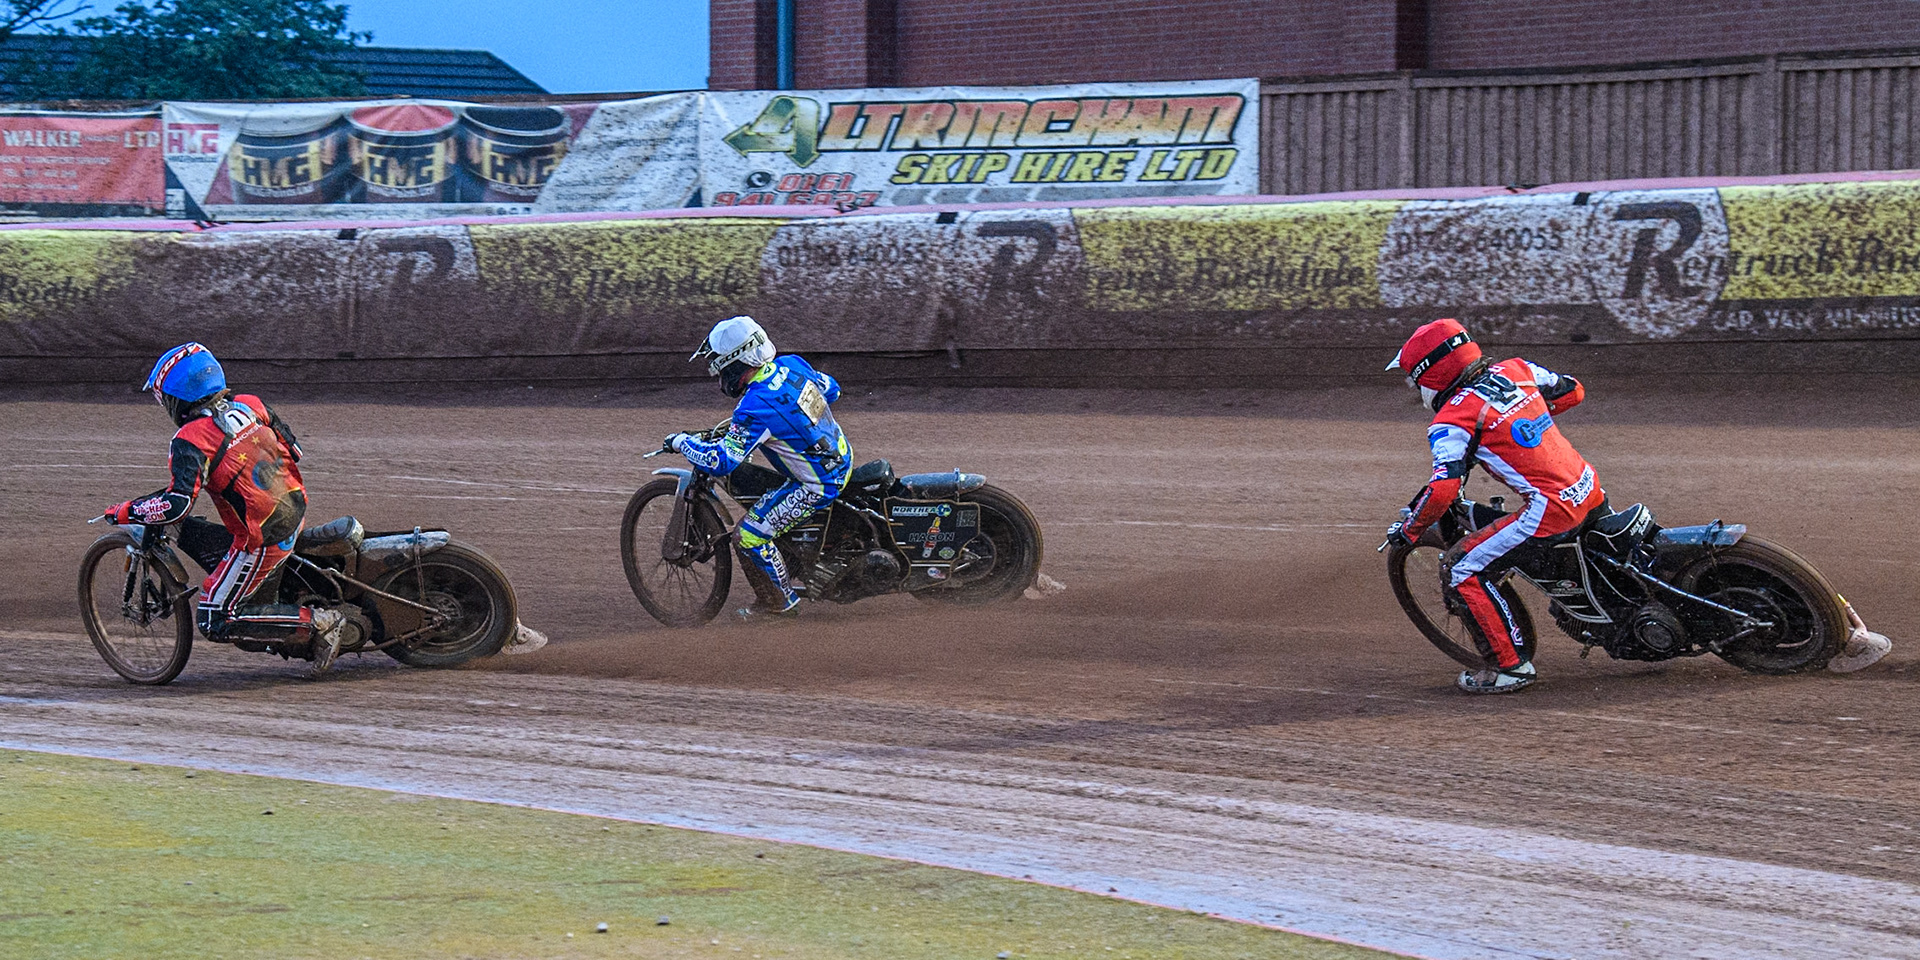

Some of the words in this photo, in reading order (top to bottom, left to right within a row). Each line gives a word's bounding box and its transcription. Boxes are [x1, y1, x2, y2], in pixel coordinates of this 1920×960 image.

[3, 130, 82, 147] WALKER
[123, 131, 161, 148] LTD
[167, 131, 217, 153] HMG
[722, 92, 1245, 168] ALTRINCHAM
[241, 154, 312, 188] HMG
[367, 153, 436, 187] HMG
[890, 150, 1011, 185] SKIP
[1010, 148, 1132, 184] HIRE
[1137, 147, 1240, 182] LTD
[776, 172, 855, 192] 0161
[719, 338, 755, 365] SCOTT
[1411, 358, 1431, 381] UST1
[908, 532, 955, 543] HAGON
